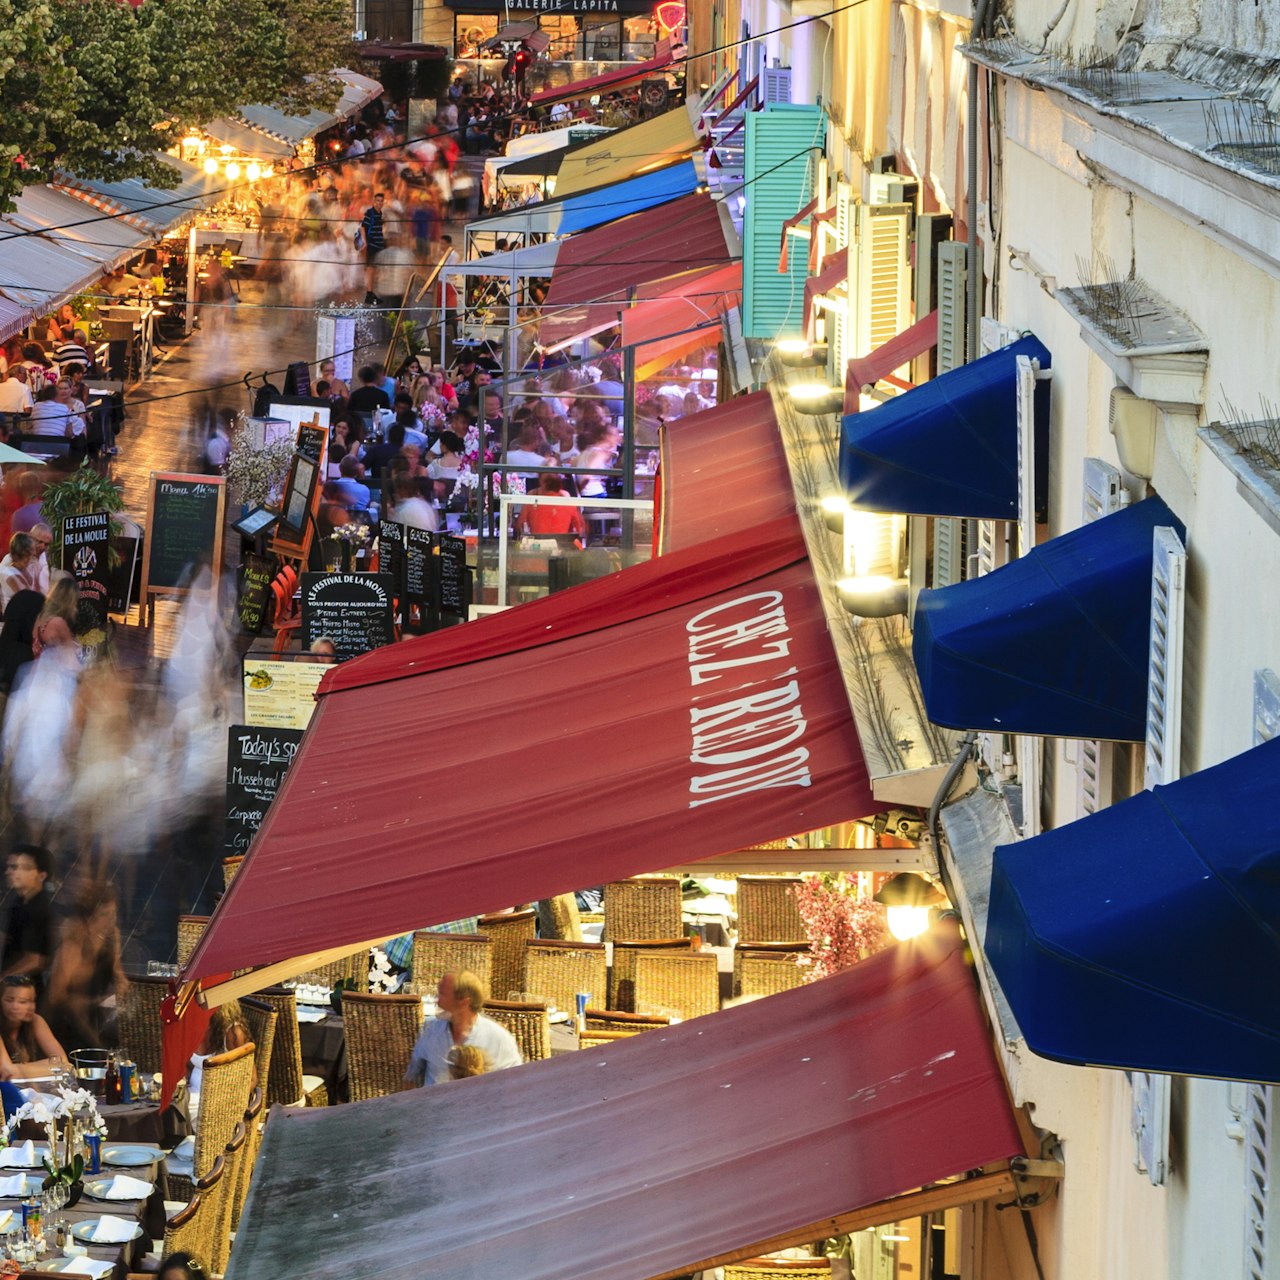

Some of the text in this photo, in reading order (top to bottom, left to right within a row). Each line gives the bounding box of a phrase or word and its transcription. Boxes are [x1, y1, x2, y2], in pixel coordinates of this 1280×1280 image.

[574, 0, 618, 10] LAPITA
[161, 483, 188, 495] Menu
[66, 514, 107, 530] LE FESTIVAL
[65, 528, 107, 545] DE LA MOULE
[410, 528, 430, 544] GLACES
[308, 575, 387, 602] LE FESTIVAL DE LA MOULE
[238, 734, 280, 765] Today's
[232, 766, 263, 786] Mussels
[264, 771, 279, 788] and
